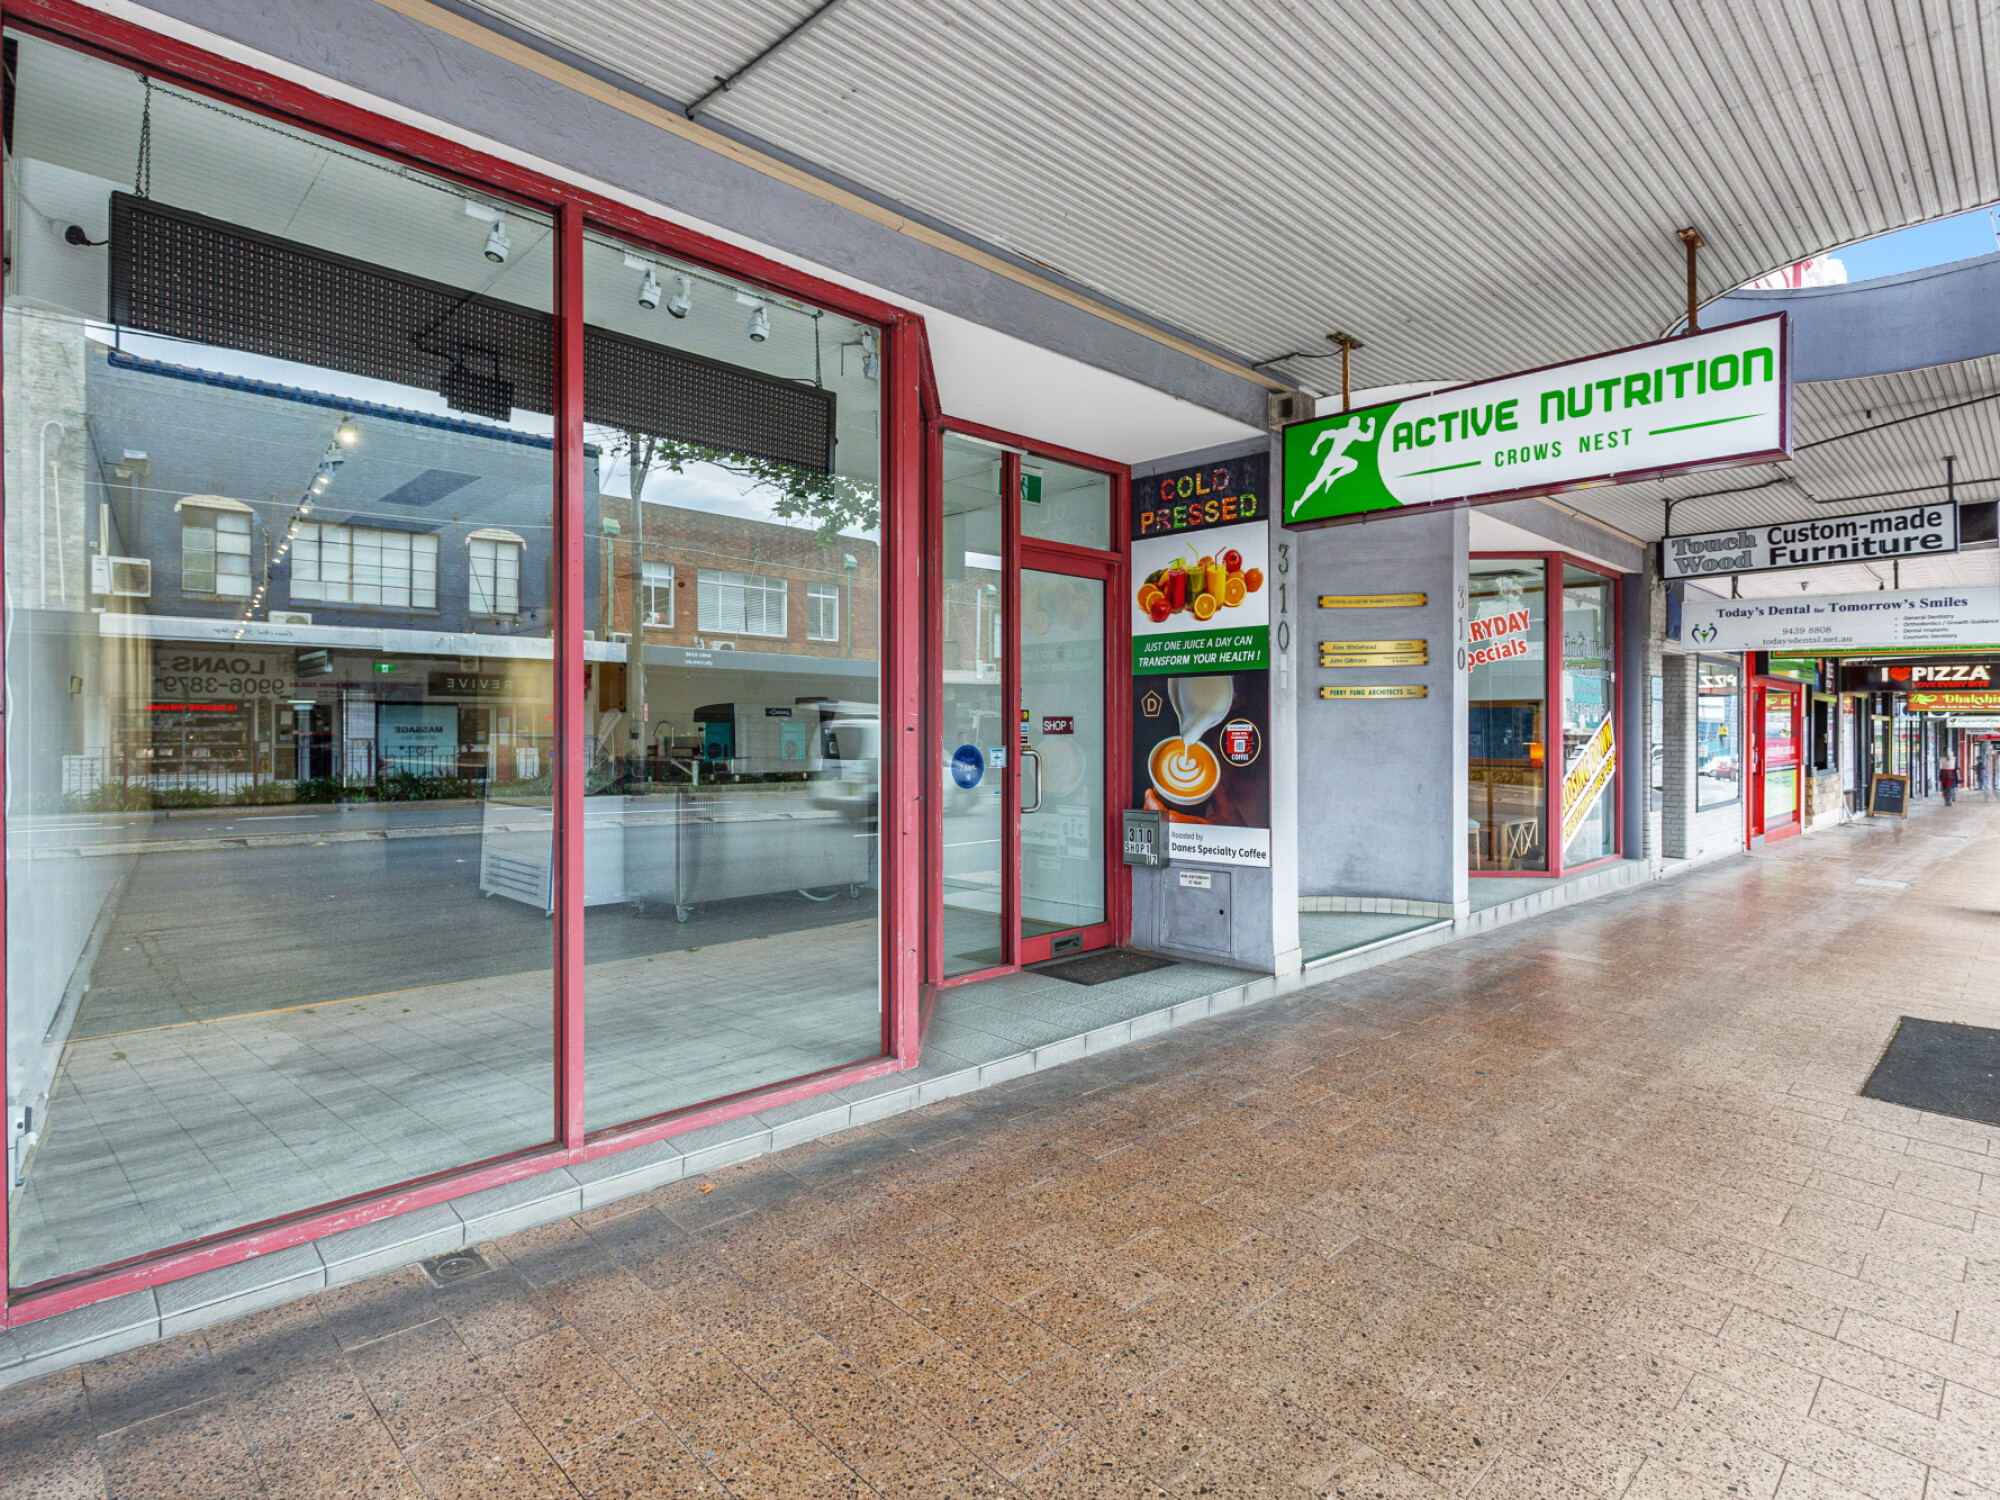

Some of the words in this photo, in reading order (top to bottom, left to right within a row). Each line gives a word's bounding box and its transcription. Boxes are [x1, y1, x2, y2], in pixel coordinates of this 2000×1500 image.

[1392, 398, 1518, 453] ACTIVE
[1540, 346, 1774, 424] NUTRITION
[1494, 440, 1563, 468] CROWS
[1578, 427, 1633, 454] NEST
[1160, 468, 1230, 500] COLD
[1140, 493, 1258, 535] PRESSED
[1767, 510, 1943, 546] Custom-made
[1671, 531, 1757, 556] Touch
[1769, 533, 1944, 566] Furniture
[1673, 550, 1754, 574] Wood
[1716, 606, 1765, 619] Today's
[1767, 604, 1811, 616] Dental
[1828, 599, 1916, 613] Tomorrow's
[1919, 596, 1968, 608] Smiles
[1468, 608, 1530, 643] RYDAY
[1782, 627, 1805, 635] 9439
[1808, 626, 1832, 634] 8808
[1144, 641, 1163, 652] JUST
[1164, 640, 1182, 651] ONE
[1182, 638, 1206, 650] JUICE
[1206, 638, 1213, 648] A
[1215, 636, 1233, 648] DAY
[1233, 635, 1253, 646] CAN
[1762, 636, 1853, 645] todaysdental.net.au
[1138, 654, 1191, 667] TRANSFORM
[1193, 652, 1217, 664] YOUR
[1219, 650, 1255, 662] HEALTH
[1881, 667, 1889, 682] I
[1912, 665, 1991, 681] PIZZA
[1368, 688, 1404, 696] ARCHITECTS
[1967, 680, 1989, 688] BITE
[1147, 697, 1157, 713] D
[1043, 721, 1067, 731] SHOP
[1068, 721, 1074, 731] 1
[1589, 718, 1613, 774] DOWN
[1129, 828, 1152, 843] 310
[1171, 831, 1195, 840] Roasted
[1196, 832, 1204, 842] by
[1171, 842, 1196, 853] Danes
[1197, 844, 1237, 858] Specialty
[1238, 848, 1267, 859] Coffee
